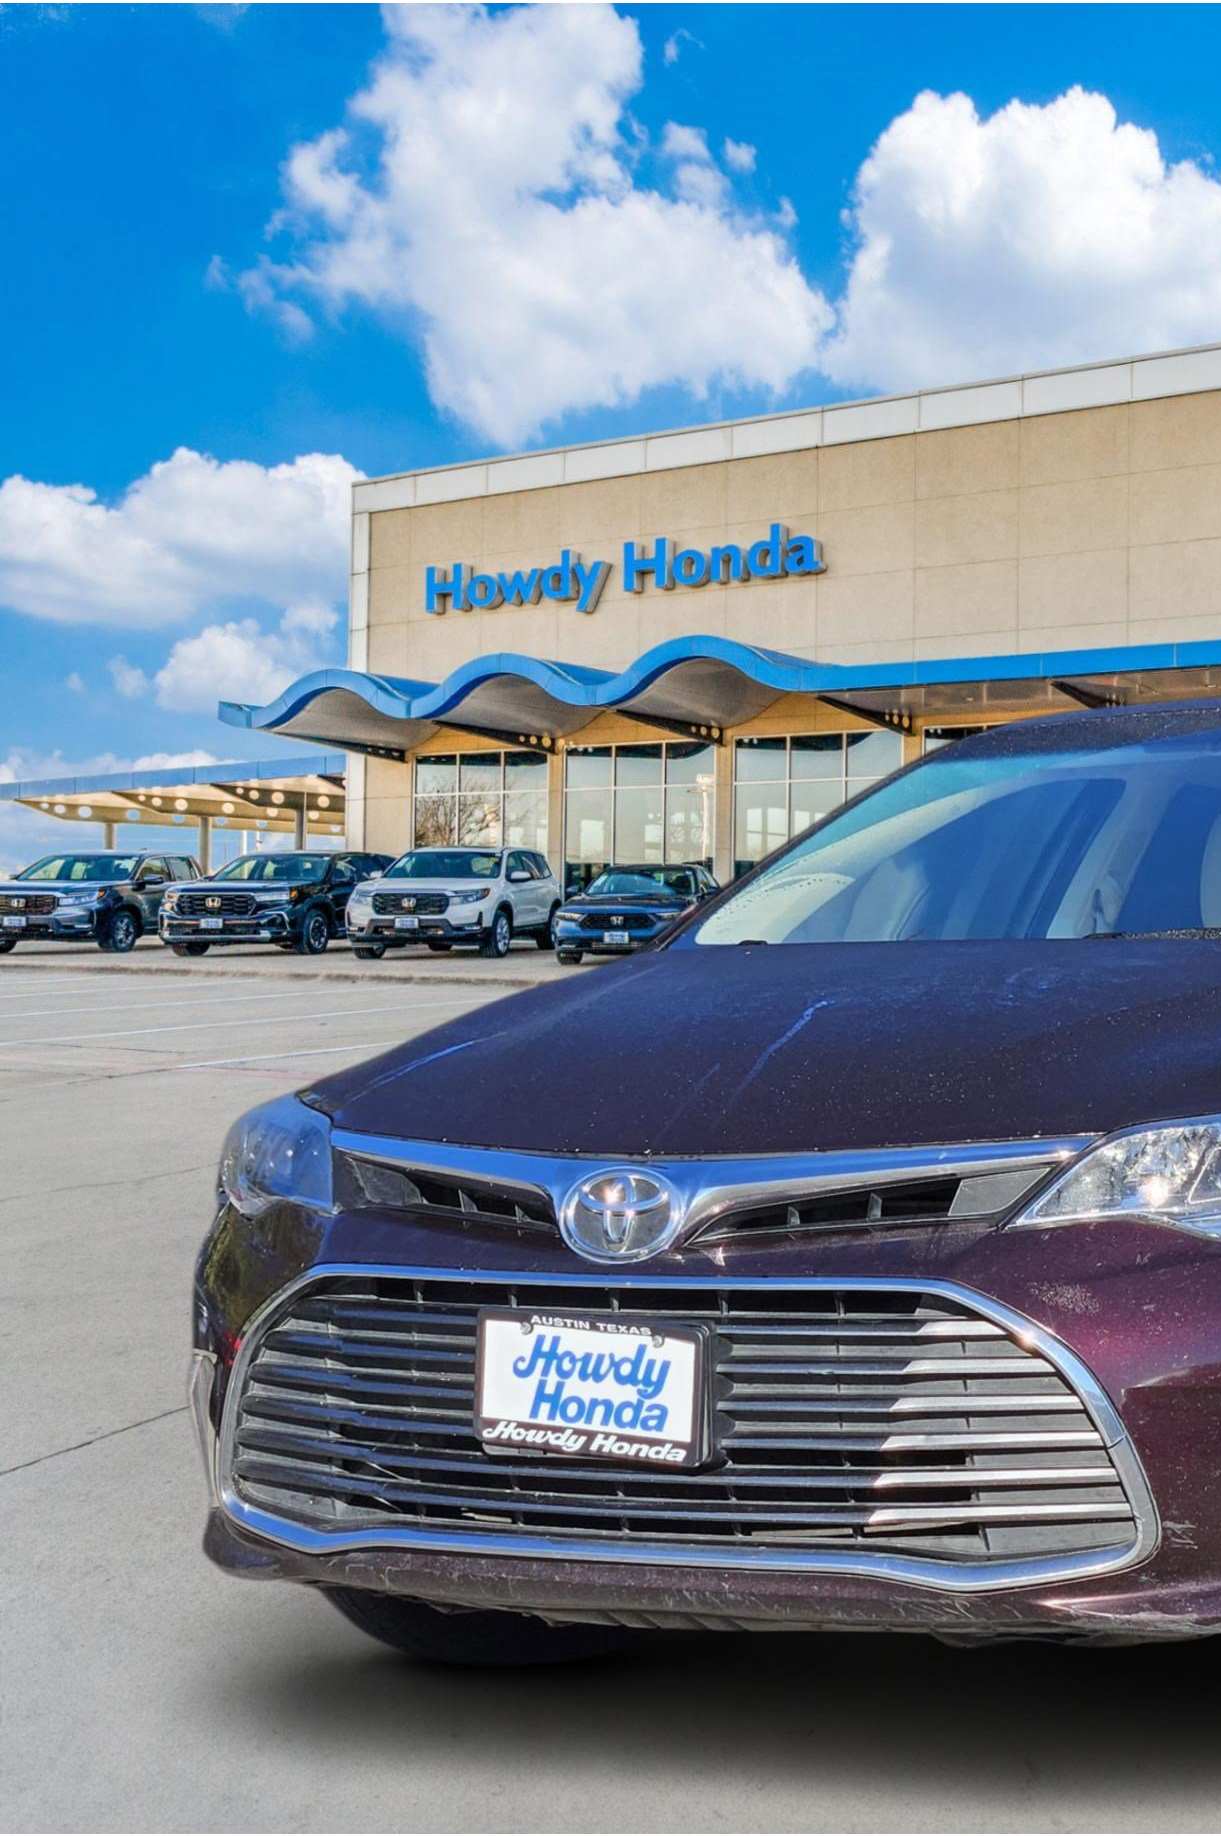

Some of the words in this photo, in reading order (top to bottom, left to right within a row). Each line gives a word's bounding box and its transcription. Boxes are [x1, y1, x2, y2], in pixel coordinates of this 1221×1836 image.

[425, 549, 612, 614] Howdy
[623, 523, 827, 593] Honda
[530, 1314, 591, 1331] AUSTIN
[596, 1322, 652, 1336] TEXAS
[512, 1334, 672, 1400] Howdy
[529, 1378, 670, 1432] Honda
[482, 1420, 588, 1452] Howdy
[589, 1433, 687, 1462] Honda
